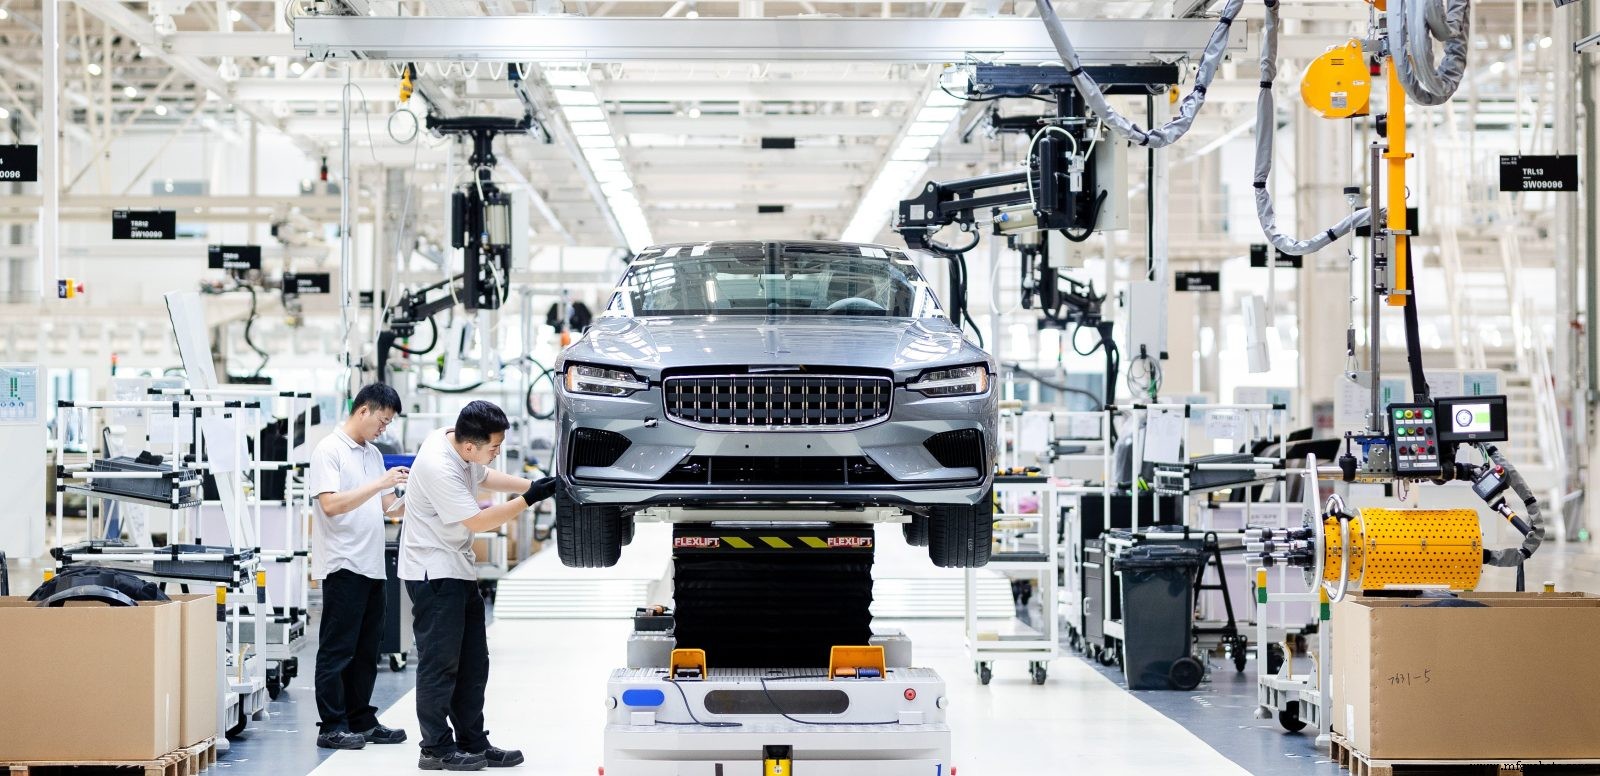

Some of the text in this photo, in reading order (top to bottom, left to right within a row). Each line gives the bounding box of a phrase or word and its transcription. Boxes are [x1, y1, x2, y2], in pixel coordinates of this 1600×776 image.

[1522, 168, 1544, 176] TRL13
[1522, 181, 1563, 189] 3W09096
[675, 537, 720, 546] FLEXLIFT
[827, 537, 872, 546] FLEXLIFT
